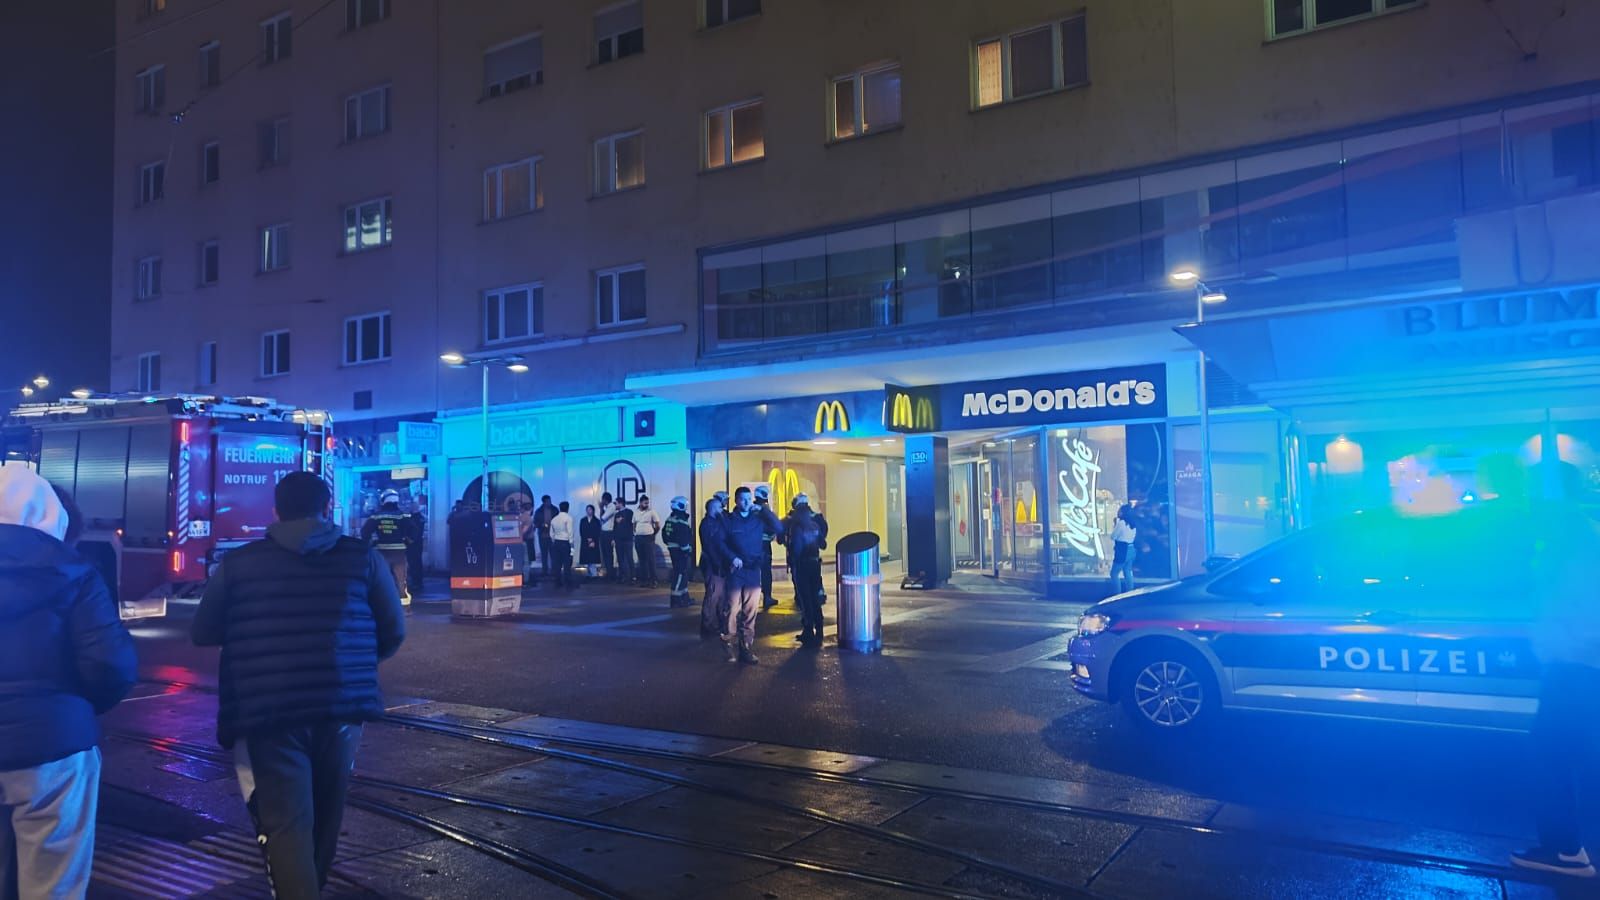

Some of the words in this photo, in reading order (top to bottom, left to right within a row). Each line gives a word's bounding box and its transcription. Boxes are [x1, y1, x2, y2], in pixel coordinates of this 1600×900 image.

[961, 379, 1156, 417] McDonald's
[407, 424, 436, 438] back
[489, 420, 537, 446] back
[224, 447, 295, 464] FEUERWEHR
[224, 474, 268, 485] NOTRUF
[1060, 437, 1103, 561] McCafé
[1319, 645, 1487, 675] POLIZEI
